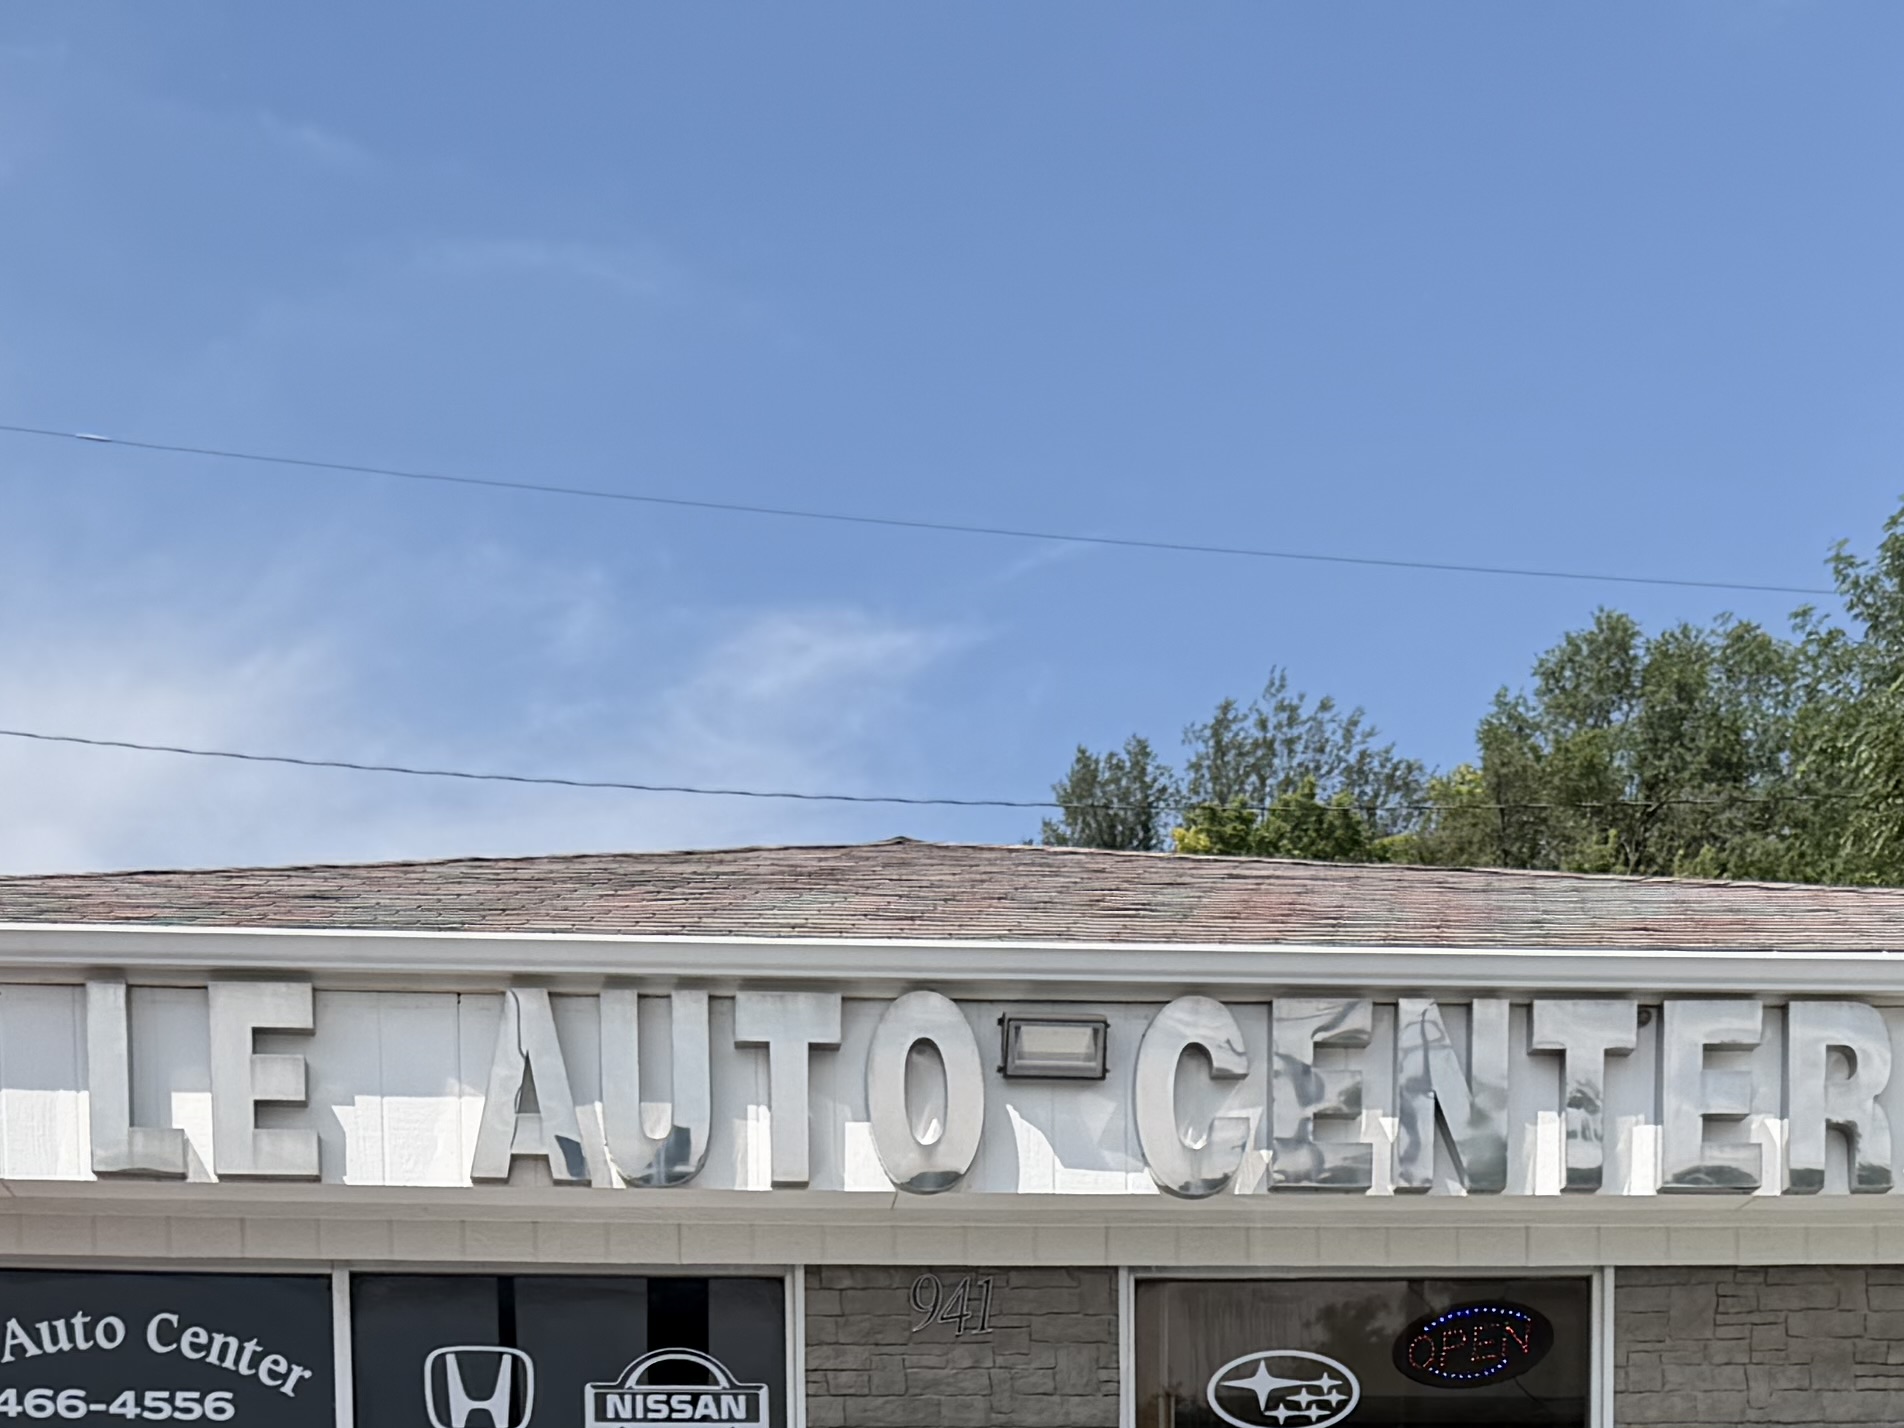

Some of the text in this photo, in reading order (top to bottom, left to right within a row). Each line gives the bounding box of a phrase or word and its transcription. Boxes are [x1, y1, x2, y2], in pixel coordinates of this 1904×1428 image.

[85, 979, 1893, 1198] LE AUTO CENTER
[910, 1274, 993, 1336] 941
[0, 1311, 126, 1363] Auto
[146, 1312, 313, 1397] Center
[1408, 1318, 1532, 1370] OPEN
[606, 1394, 747, 1420] NISSAN
